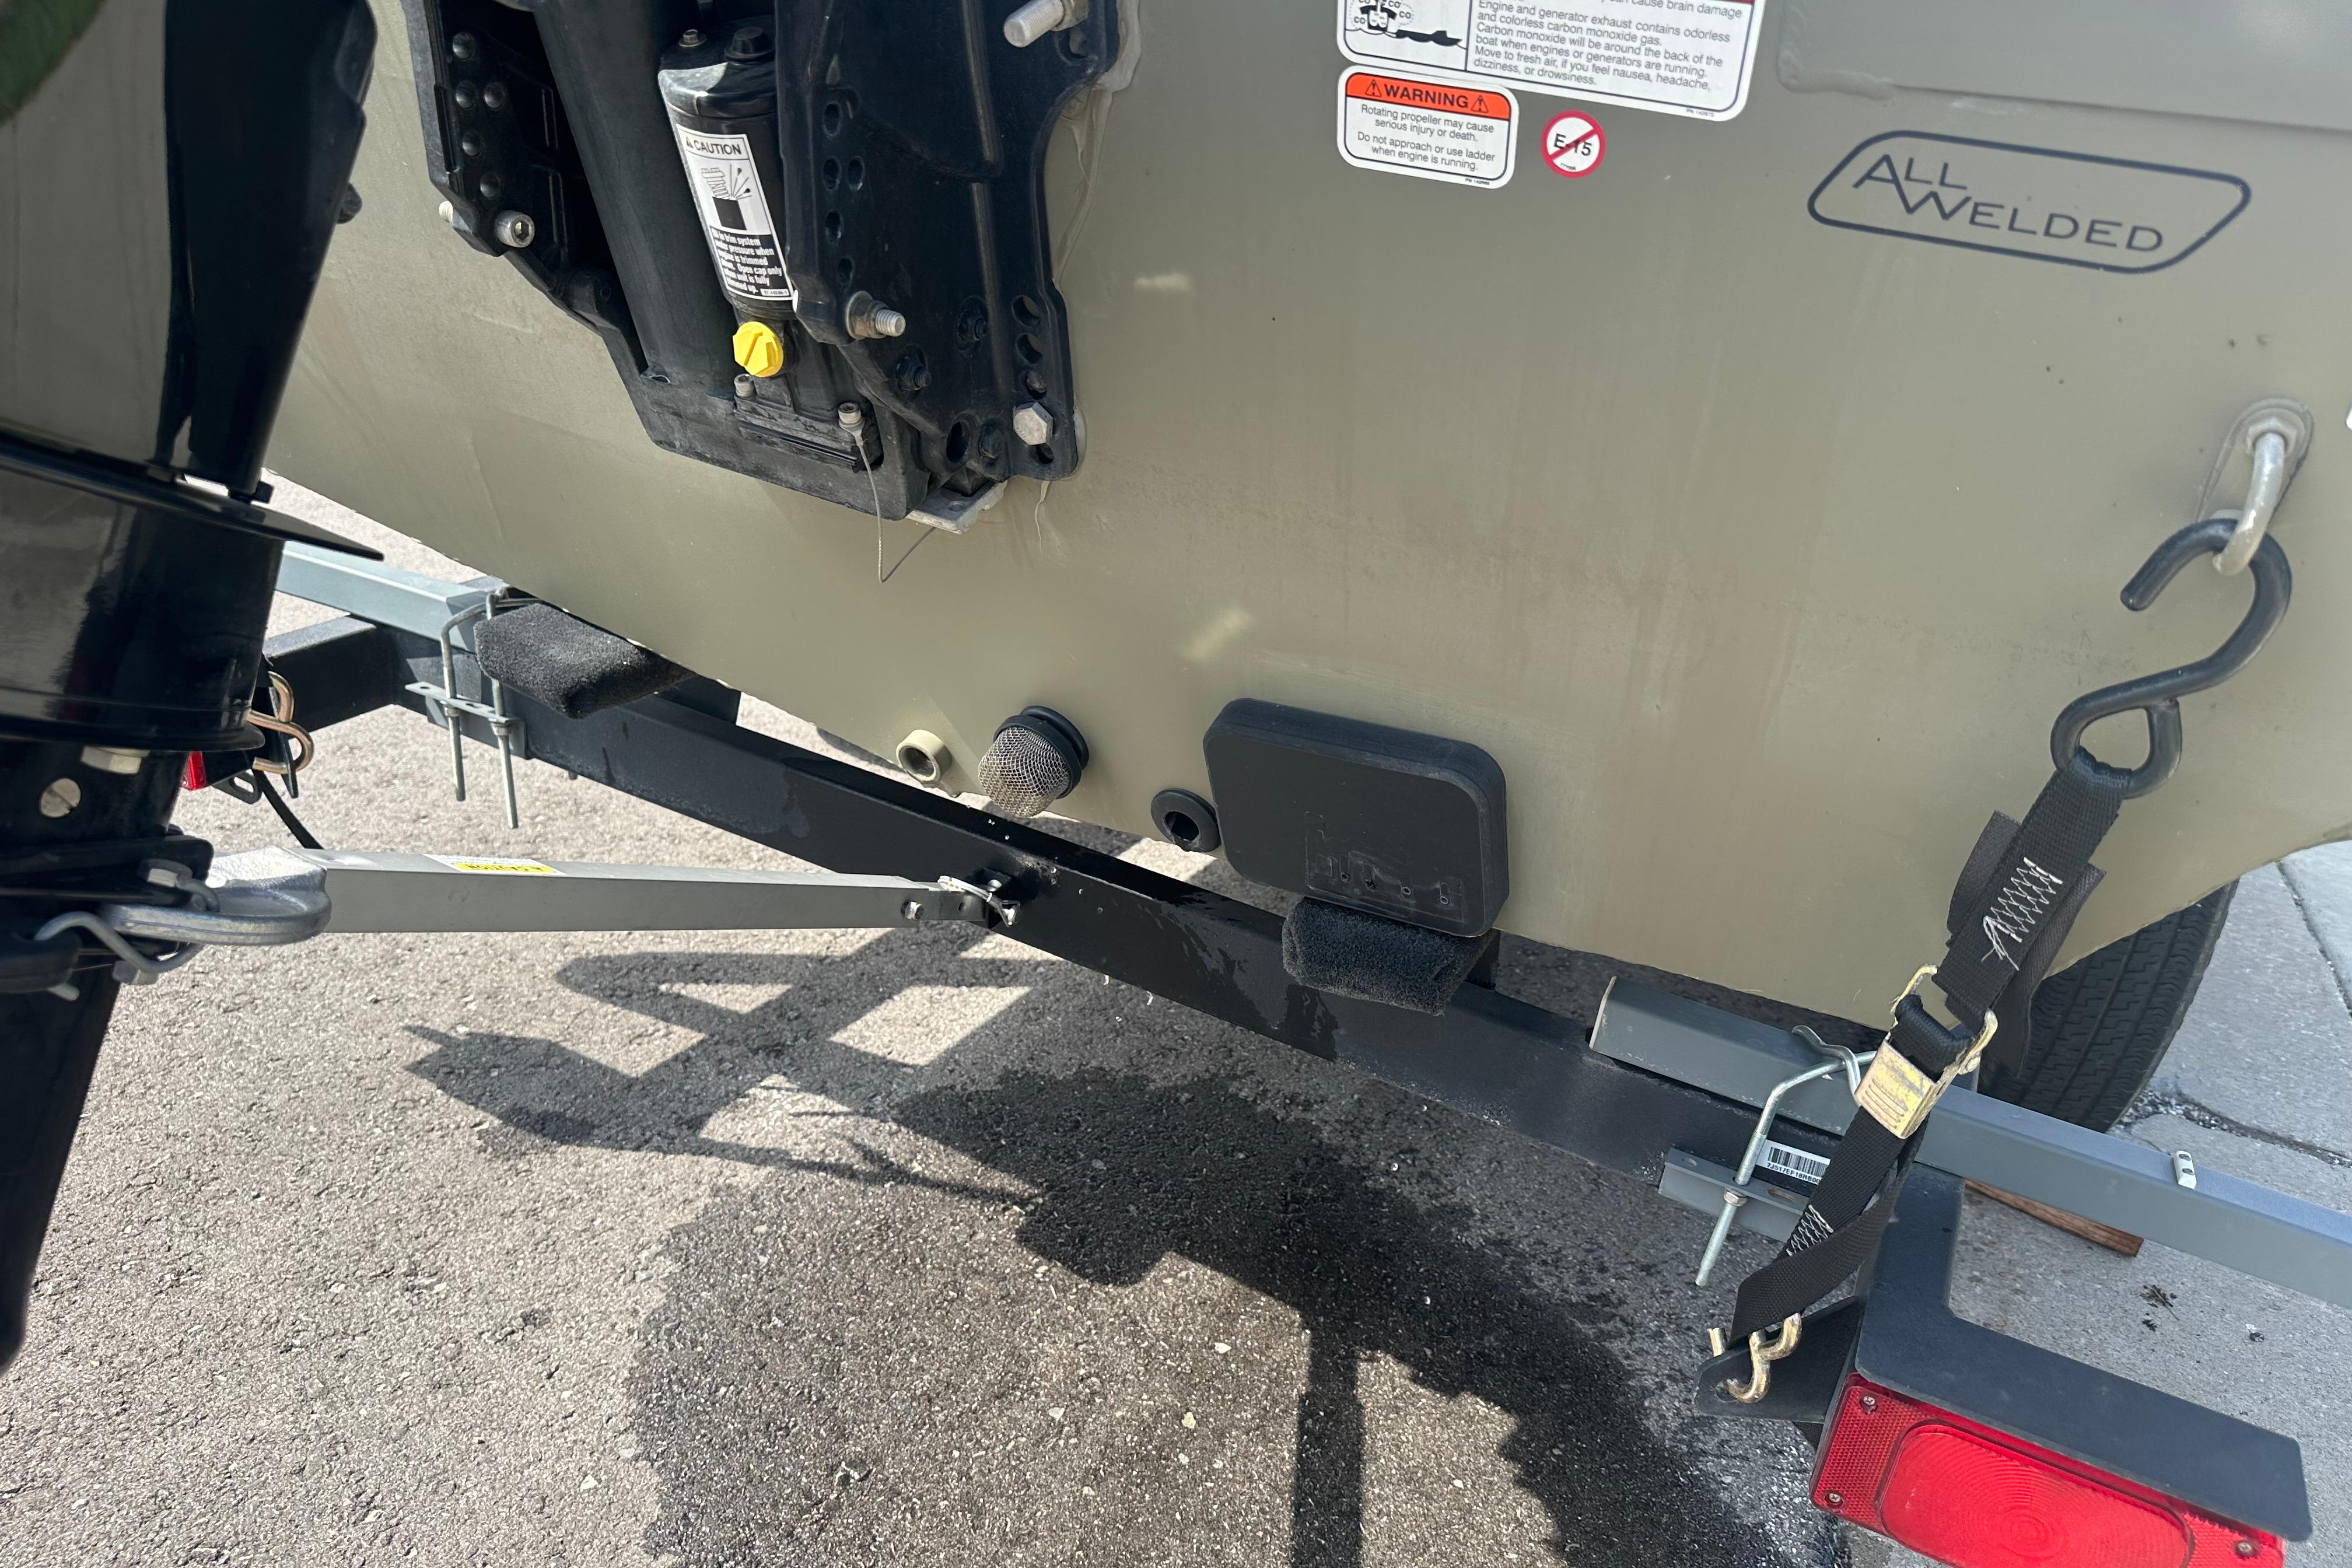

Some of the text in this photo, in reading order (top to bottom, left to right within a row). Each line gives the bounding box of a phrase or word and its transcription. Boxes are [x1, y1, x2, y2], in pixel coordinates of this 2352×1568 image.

[1479, 0, 1730, 43] Engine and generator exhaust contains odorless
[1667, 1, 1693, 12] brain
[1697, 5, 1742, 20] damage
[1478, 12, 1662, 46] and colorless carbon monoxide gas.
[1476, 34, 1498, 46] boat
[1501, 39, 1527, 50] when
[1530, 44, 1569, 57] engines
[1586, 52, 1642, 68] generators
[1644, 61, 1661, 71] are
[1664, 63, 1707, 79] running.
[1477, 22, 1723, 67] Carbon monoxide will be around the back of the
[1474, 58, 1596, 85] dizziness, or drowsiness.
[1475, 46, 1710, 91] Move to fresh air, if you feel nausea, headache,
[1384, 84, 1469, 108] WARNING
[1362, 104, 1494, 133] Rotating propeller may cause
[1375, 118, 1478, 142] serious injury or death.
[695, 138, 741, 155] CAUTION
[1357, 131, 1494, 162] Do not approach or use ladder
[1553, 133, 1592, 156] E-15
[1372, 146, 1478, 172] when engine is running.
[1852, 154, 1968, 190] ALL
[1892, 190, 2164, 252] WELDED
[729, 245, 755, 255] pressure
[755, 247, 775, 256] when
[737, 237, 761, 246] system
[737, 263, 753, 274] Open
[754, 268, 766, 276] cap
[767, 266, 782, 276] only
[740, 256, 768, 265] trimmed
[748, 275, 755, 283] is
[755, 275, 769, 286] fully
[748, 285, 758, 293] up.
